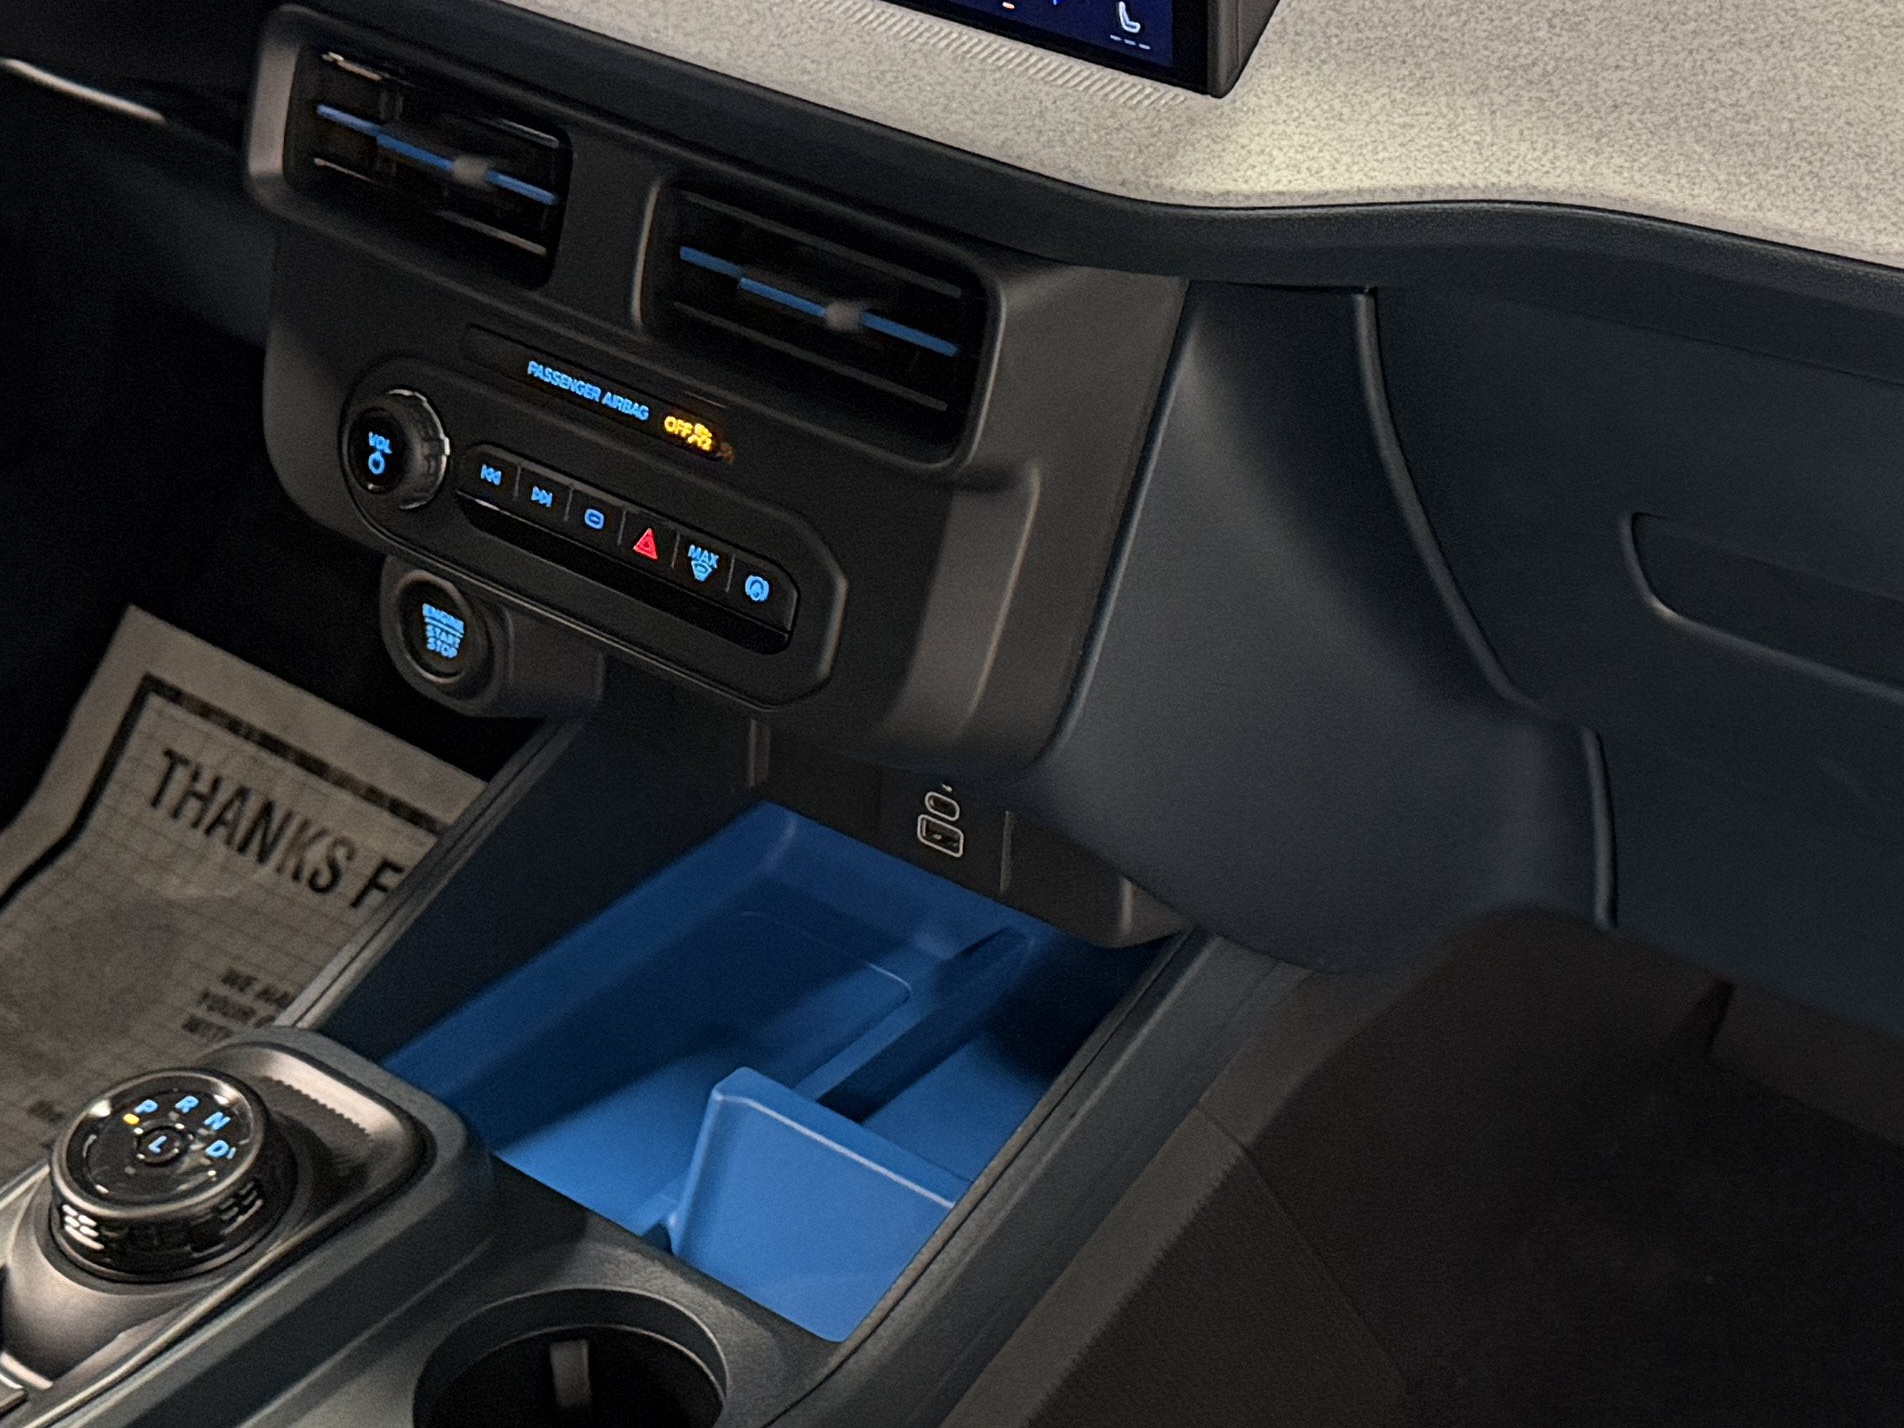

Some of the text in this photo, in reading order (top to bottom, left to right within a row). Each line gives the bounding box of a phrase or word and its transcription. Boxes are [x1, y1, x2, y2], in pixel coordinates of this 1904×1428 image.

[527, 360, 650, 420] PASSENGER AIRBAG
[664, 416, 693, 438] OFF
[368, 432, 393, 454] VOL
[688, 544, 719, 569] MAX
[426, 625, 460, 649] START
[427, 638, 458, 658] STOP
[151, 748, 357, 894] THANKS
[134, 1099, 158, 1114] P
[175, 1095, 199, 1114] R
[204, 1112, 231, 1130] N
[148, 1135, 167, 1154] L
